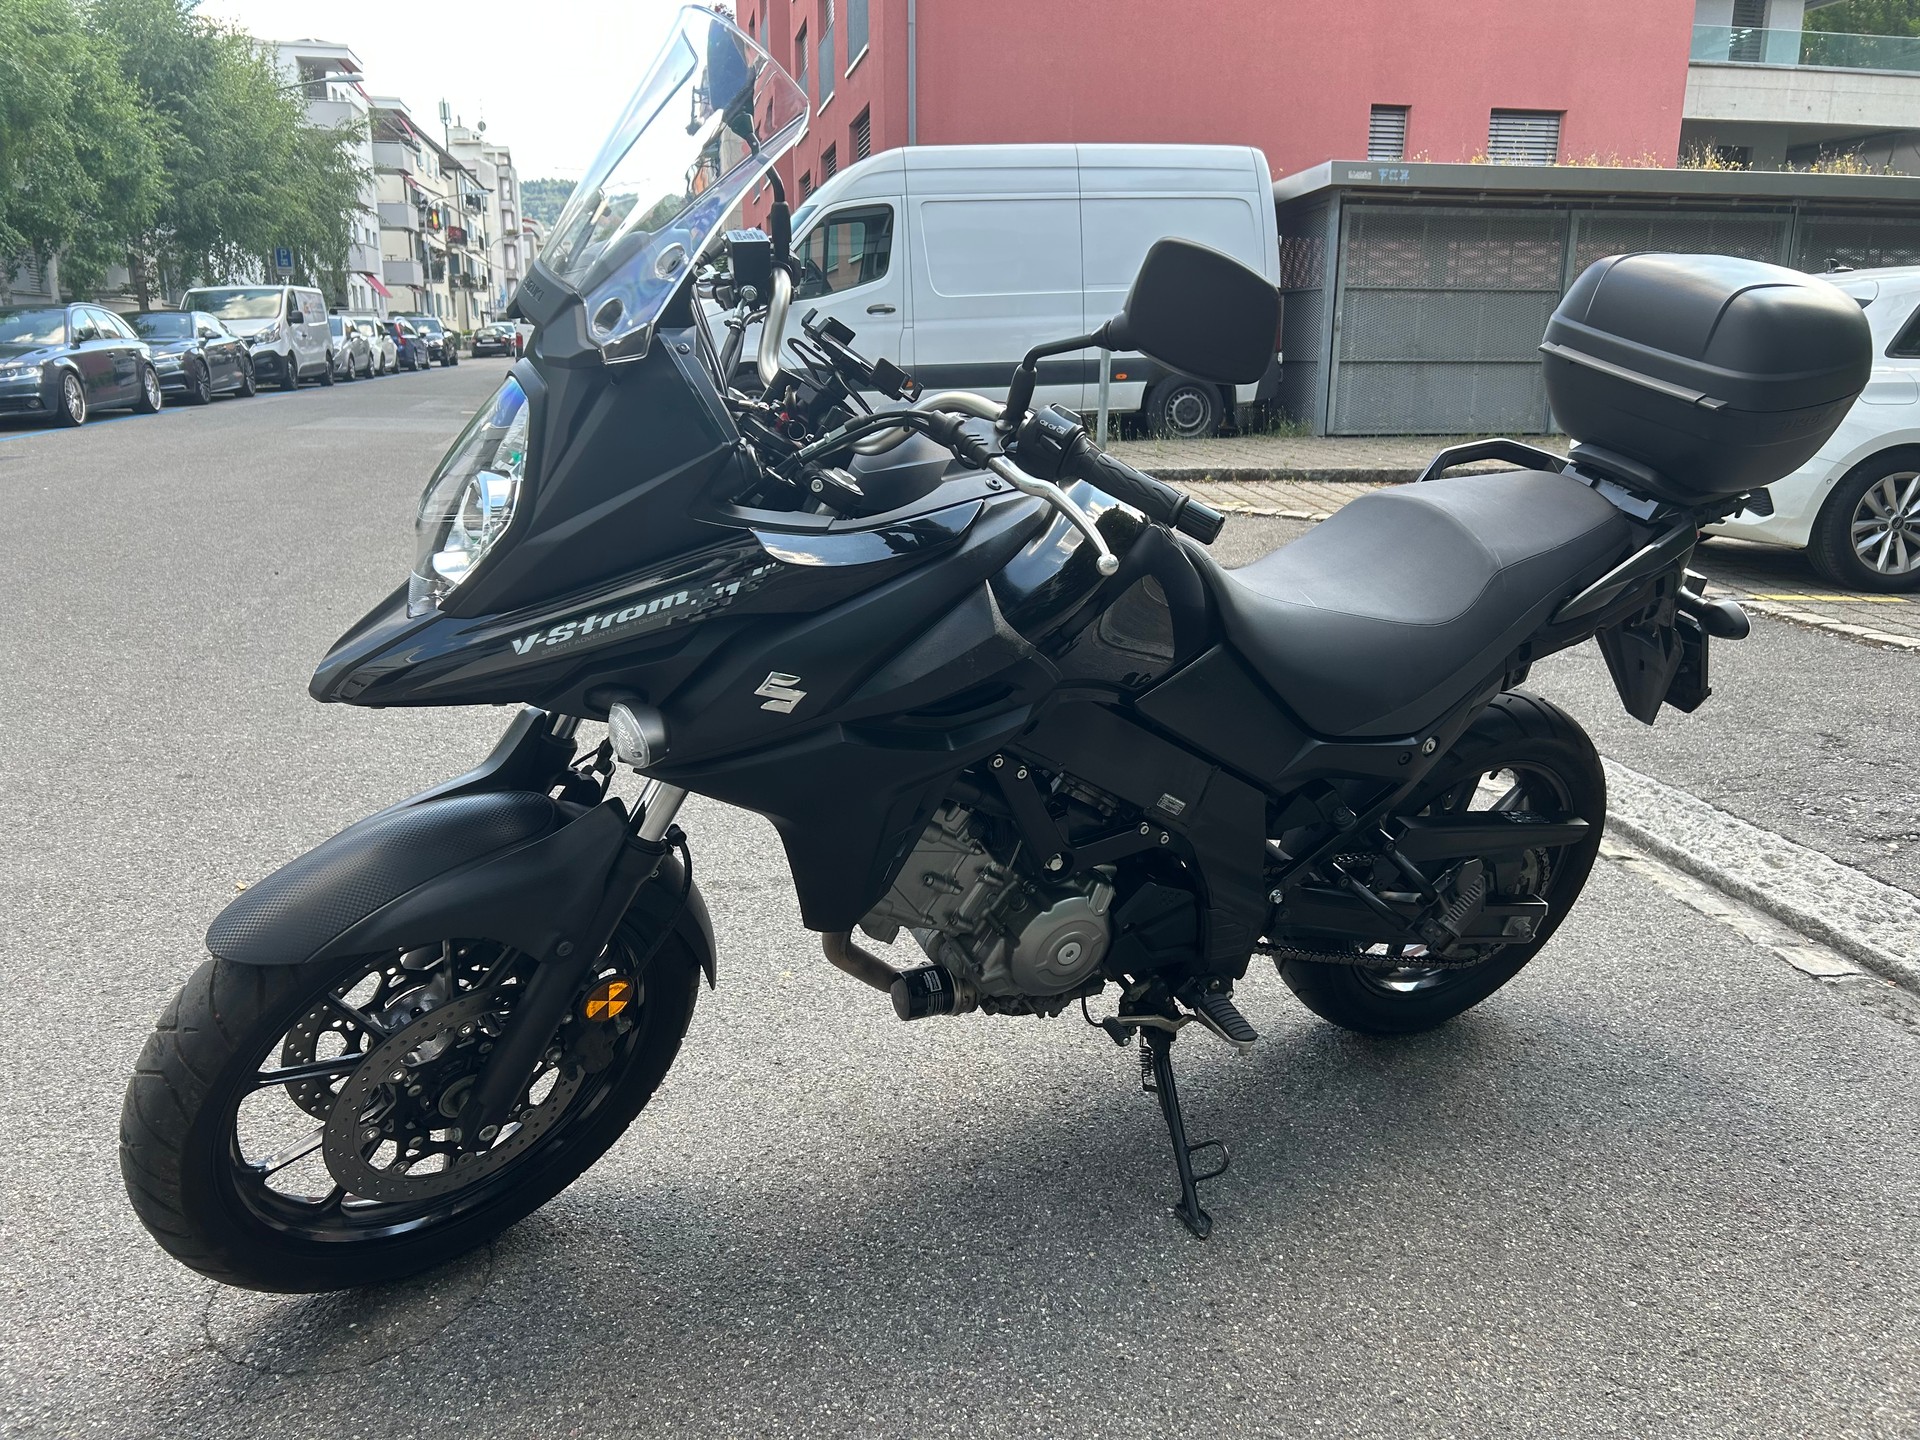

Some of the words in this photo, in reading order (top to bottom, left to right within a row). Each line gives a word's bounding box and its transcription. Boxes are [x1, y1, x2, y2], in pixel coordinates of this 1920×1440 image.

[280, 248, 287, 259] P
[512, 590, 689, 655] V-Strom
[541, 641, 572, 655] SPORT
[574, 624, 630, 644] ADVENTURE
[633, 610, 671, 626] TOURER
